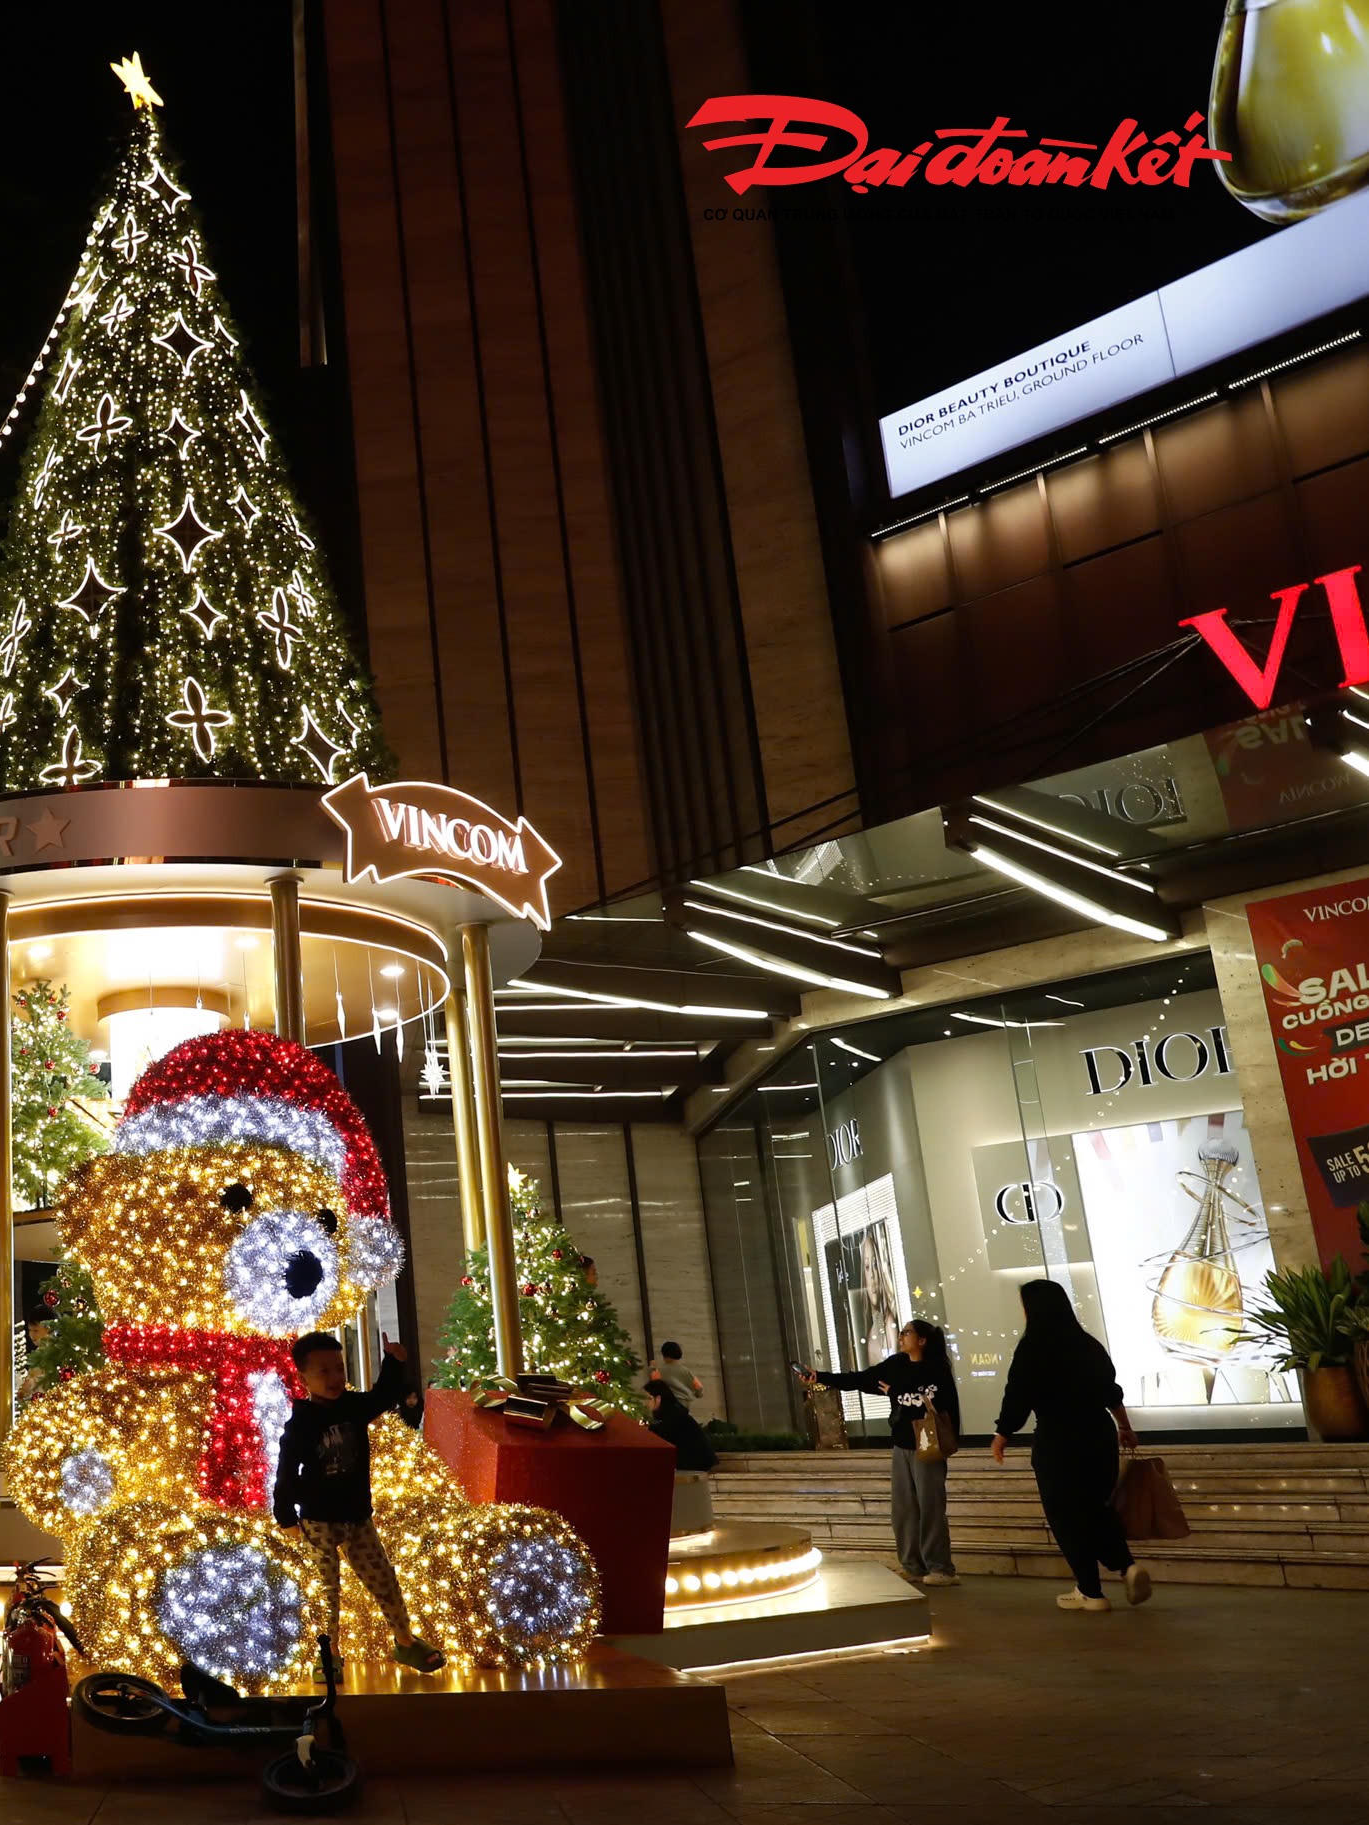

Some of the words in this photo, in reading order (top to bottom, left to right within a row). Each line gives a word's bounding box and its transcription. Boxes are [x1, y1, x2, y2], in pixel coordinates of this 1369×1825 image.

[897, 412, 935, 437] DIOR
[938, 382, 999, 419] BEAUTY
[1003, 340, 1092, 389] BOUTIQUE
[900, 419, 955, 449] VINCOM
[958, 410, 977, 425] BA
[977, 390, 1020, 416] TRIEU,
[1021, 359, 1089, 396] GROUND
[1092, 333, 1144, 365] FLOOR
[1178, 565, 1369, 711] VI
[373, 797, 529, 874] VINCOM
[1303, 896, 1369, 922] VINCO
[1326, 1152, 1354, 1172] SALE
[1333, 1169, 1347, 1184] UP
[1347, 1164, 1361, 1179] TO
